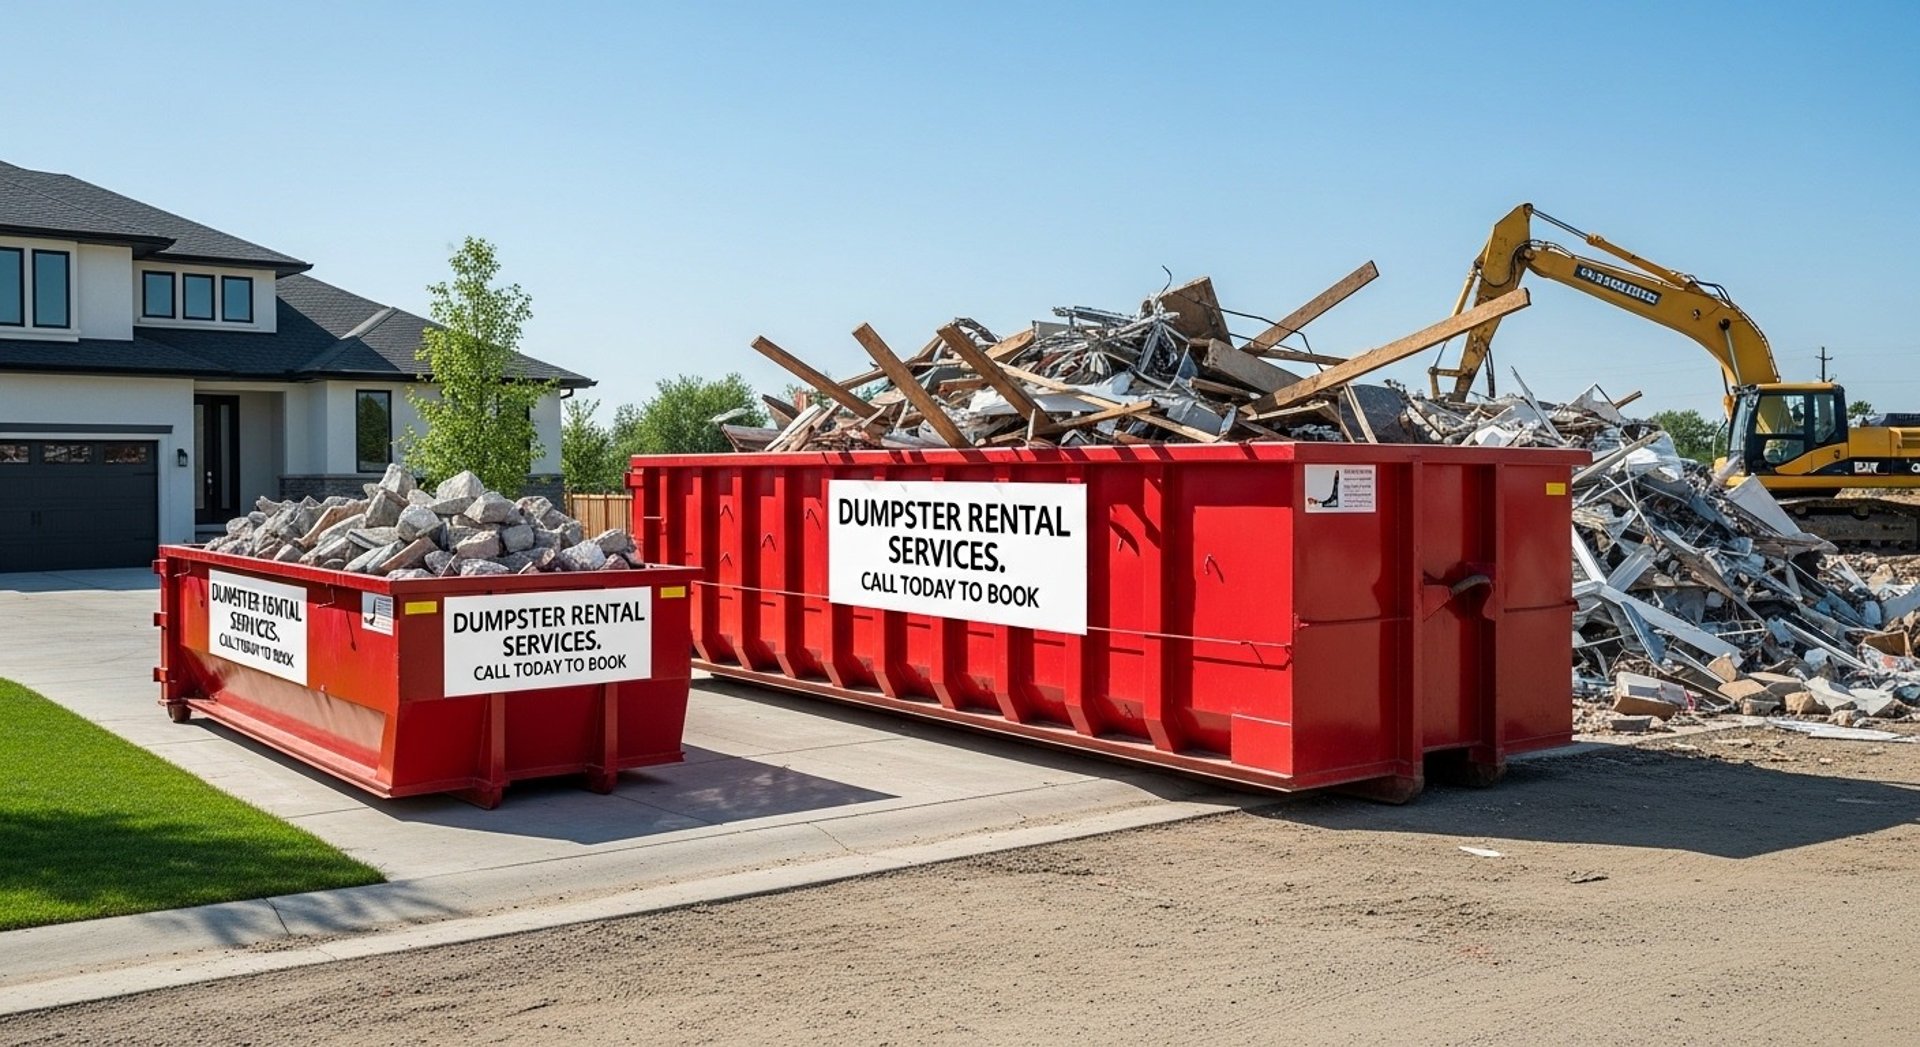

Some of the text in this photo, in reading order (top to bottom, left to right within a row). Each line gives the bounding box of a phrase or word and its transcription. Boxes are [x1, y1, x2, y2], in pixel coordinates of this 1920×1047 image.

[839, 498, 1071, 537] DUMPSTER RENTAL
[888, 535, 1006, 574] SERVICES.
[861, 571, 1040, 609] CALL TODAY TO BOOK
[453, 602, 645, 634] DUMPSTER RENTAL
[503, 630, 602, 657] SERVICES.
[474, 654, 627, 681] CALL TODAY TO BOOK
